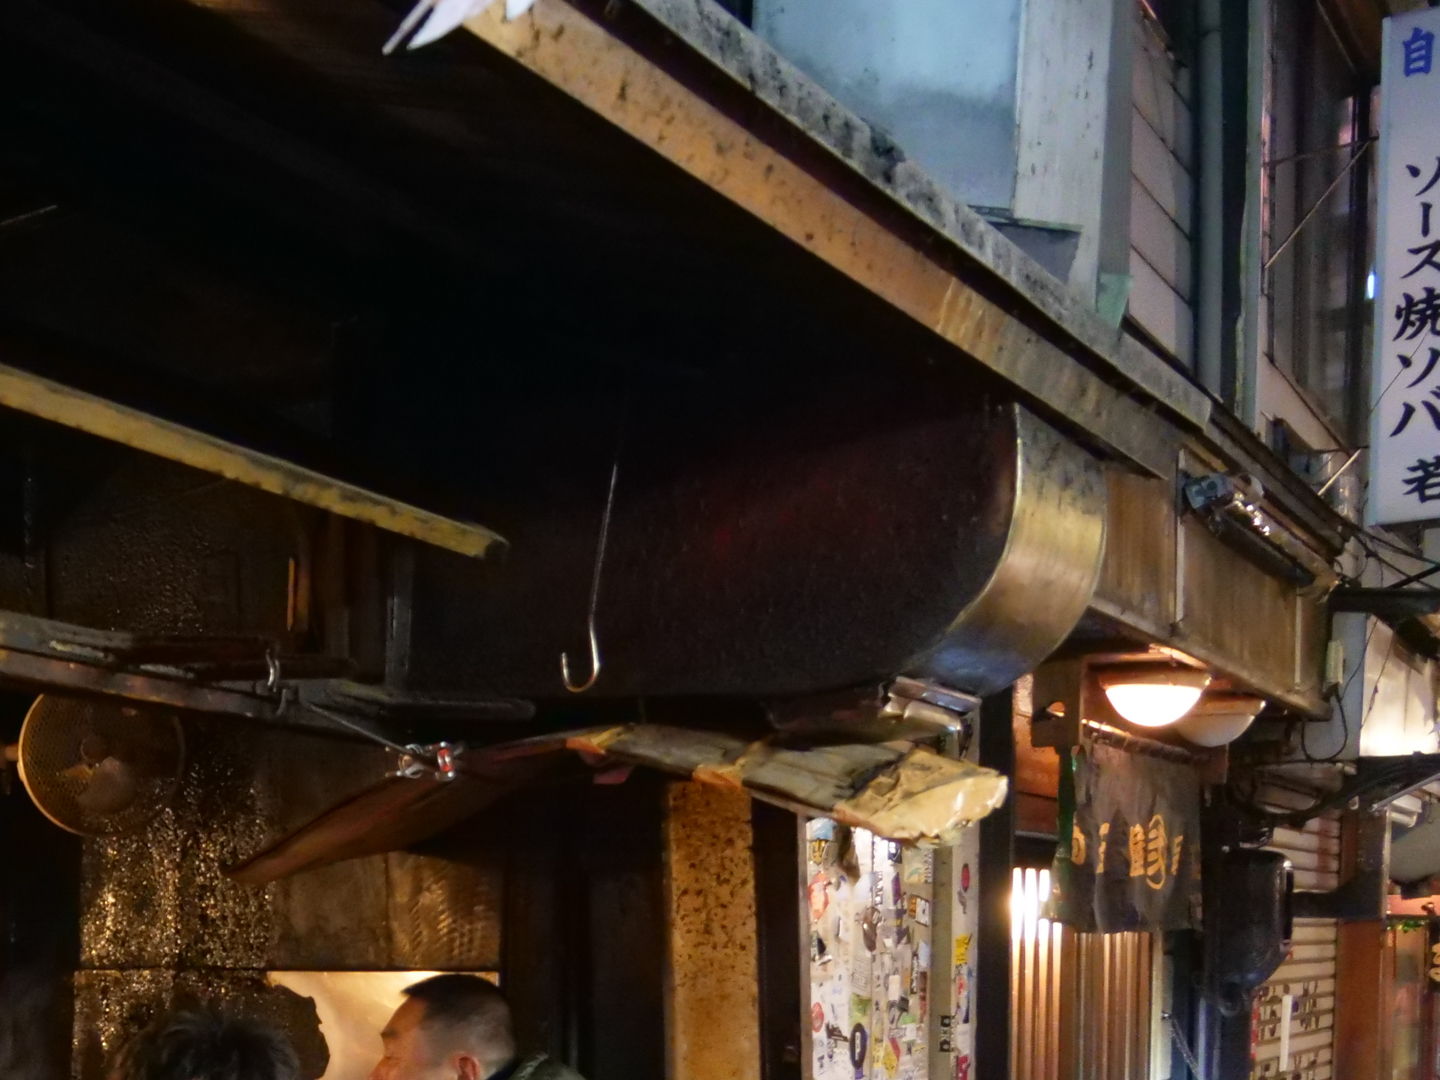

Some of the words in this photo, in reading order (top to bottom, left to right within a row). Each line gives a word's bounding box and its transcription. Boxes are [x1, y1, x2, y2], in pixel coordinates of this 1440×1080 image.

[1402, 26, 1436, 78] 自
[1389, 156, 1440, 437] ソース焼ソバ
